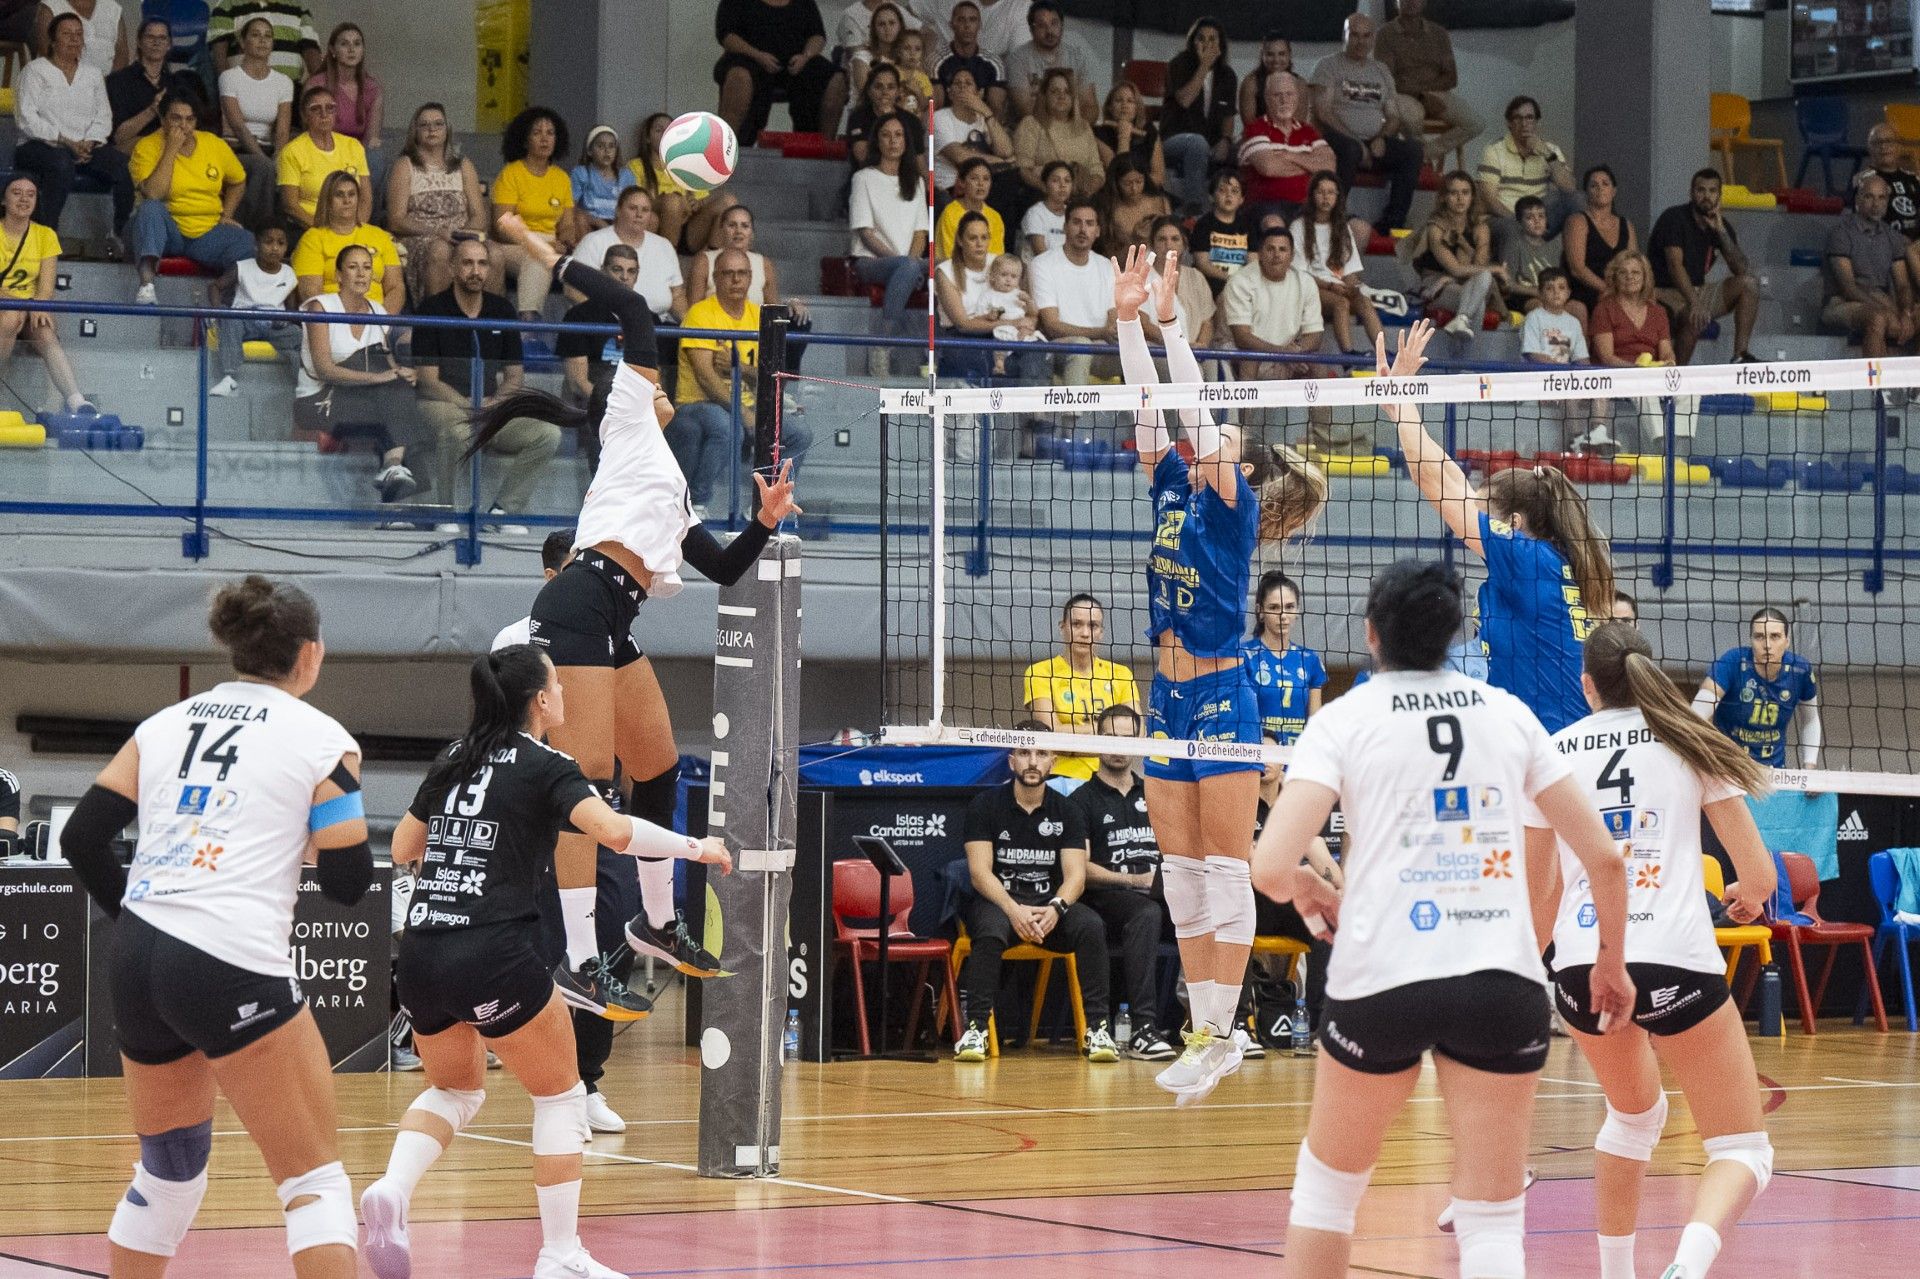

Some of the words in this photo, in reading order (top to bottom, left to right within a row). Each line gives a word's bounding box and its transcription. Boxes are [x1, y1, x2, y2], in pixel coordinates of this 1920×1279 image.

[901, 390, 952, 407] rfevm
[1044, 386, 1100, 405] rfevb.com
[1199, 384, 1259, 402] rfevb.com
[1365, 379, 1429, 397] rfevb.com
[1543, 369, 1613, 392] rfevb.com
[1736, 365, 1811, 386] rfevb.com
[1276, 679, 1294, 708] 7
[1391, 689, 1486, 712] ARANDA
[186, 701, 269, 722] HIRUELA
[178, 722, 244, 781] 14
[976, 731, 1036, 748] cdheidelberg.es
[1197, 742, 1262, 761] @cdheidelberg
[1426, 714, 1464, 782] 9
[1556, 737, 1578, 755] AN
[1584, 731, 1622, 751] DEN
[873, 769, 924, 785] elksport
[1596, 748, 1635, 804] 4
[444, 765, 494, 817] 13
[896, 813, 924, 826] Islas
[869, 824, 924, 837] Canarias
[1837, 829, 1869, 841] adidas
[1437, 851, 1480, 867] Islas
[436, 866, 461, 881] Islas
[1399, 867, 1480, 883] Canarias
[0, 882, 73, 896] rgschule.com
[417, 877, 459, 892] Canarias
[428, 909, 470, 925] Hexagon
[1446, 907, 1510, 927] Hexagon
[295, 922, 369, 939] ORTIVO
[4, 1000, 57, 1014] ARIA
